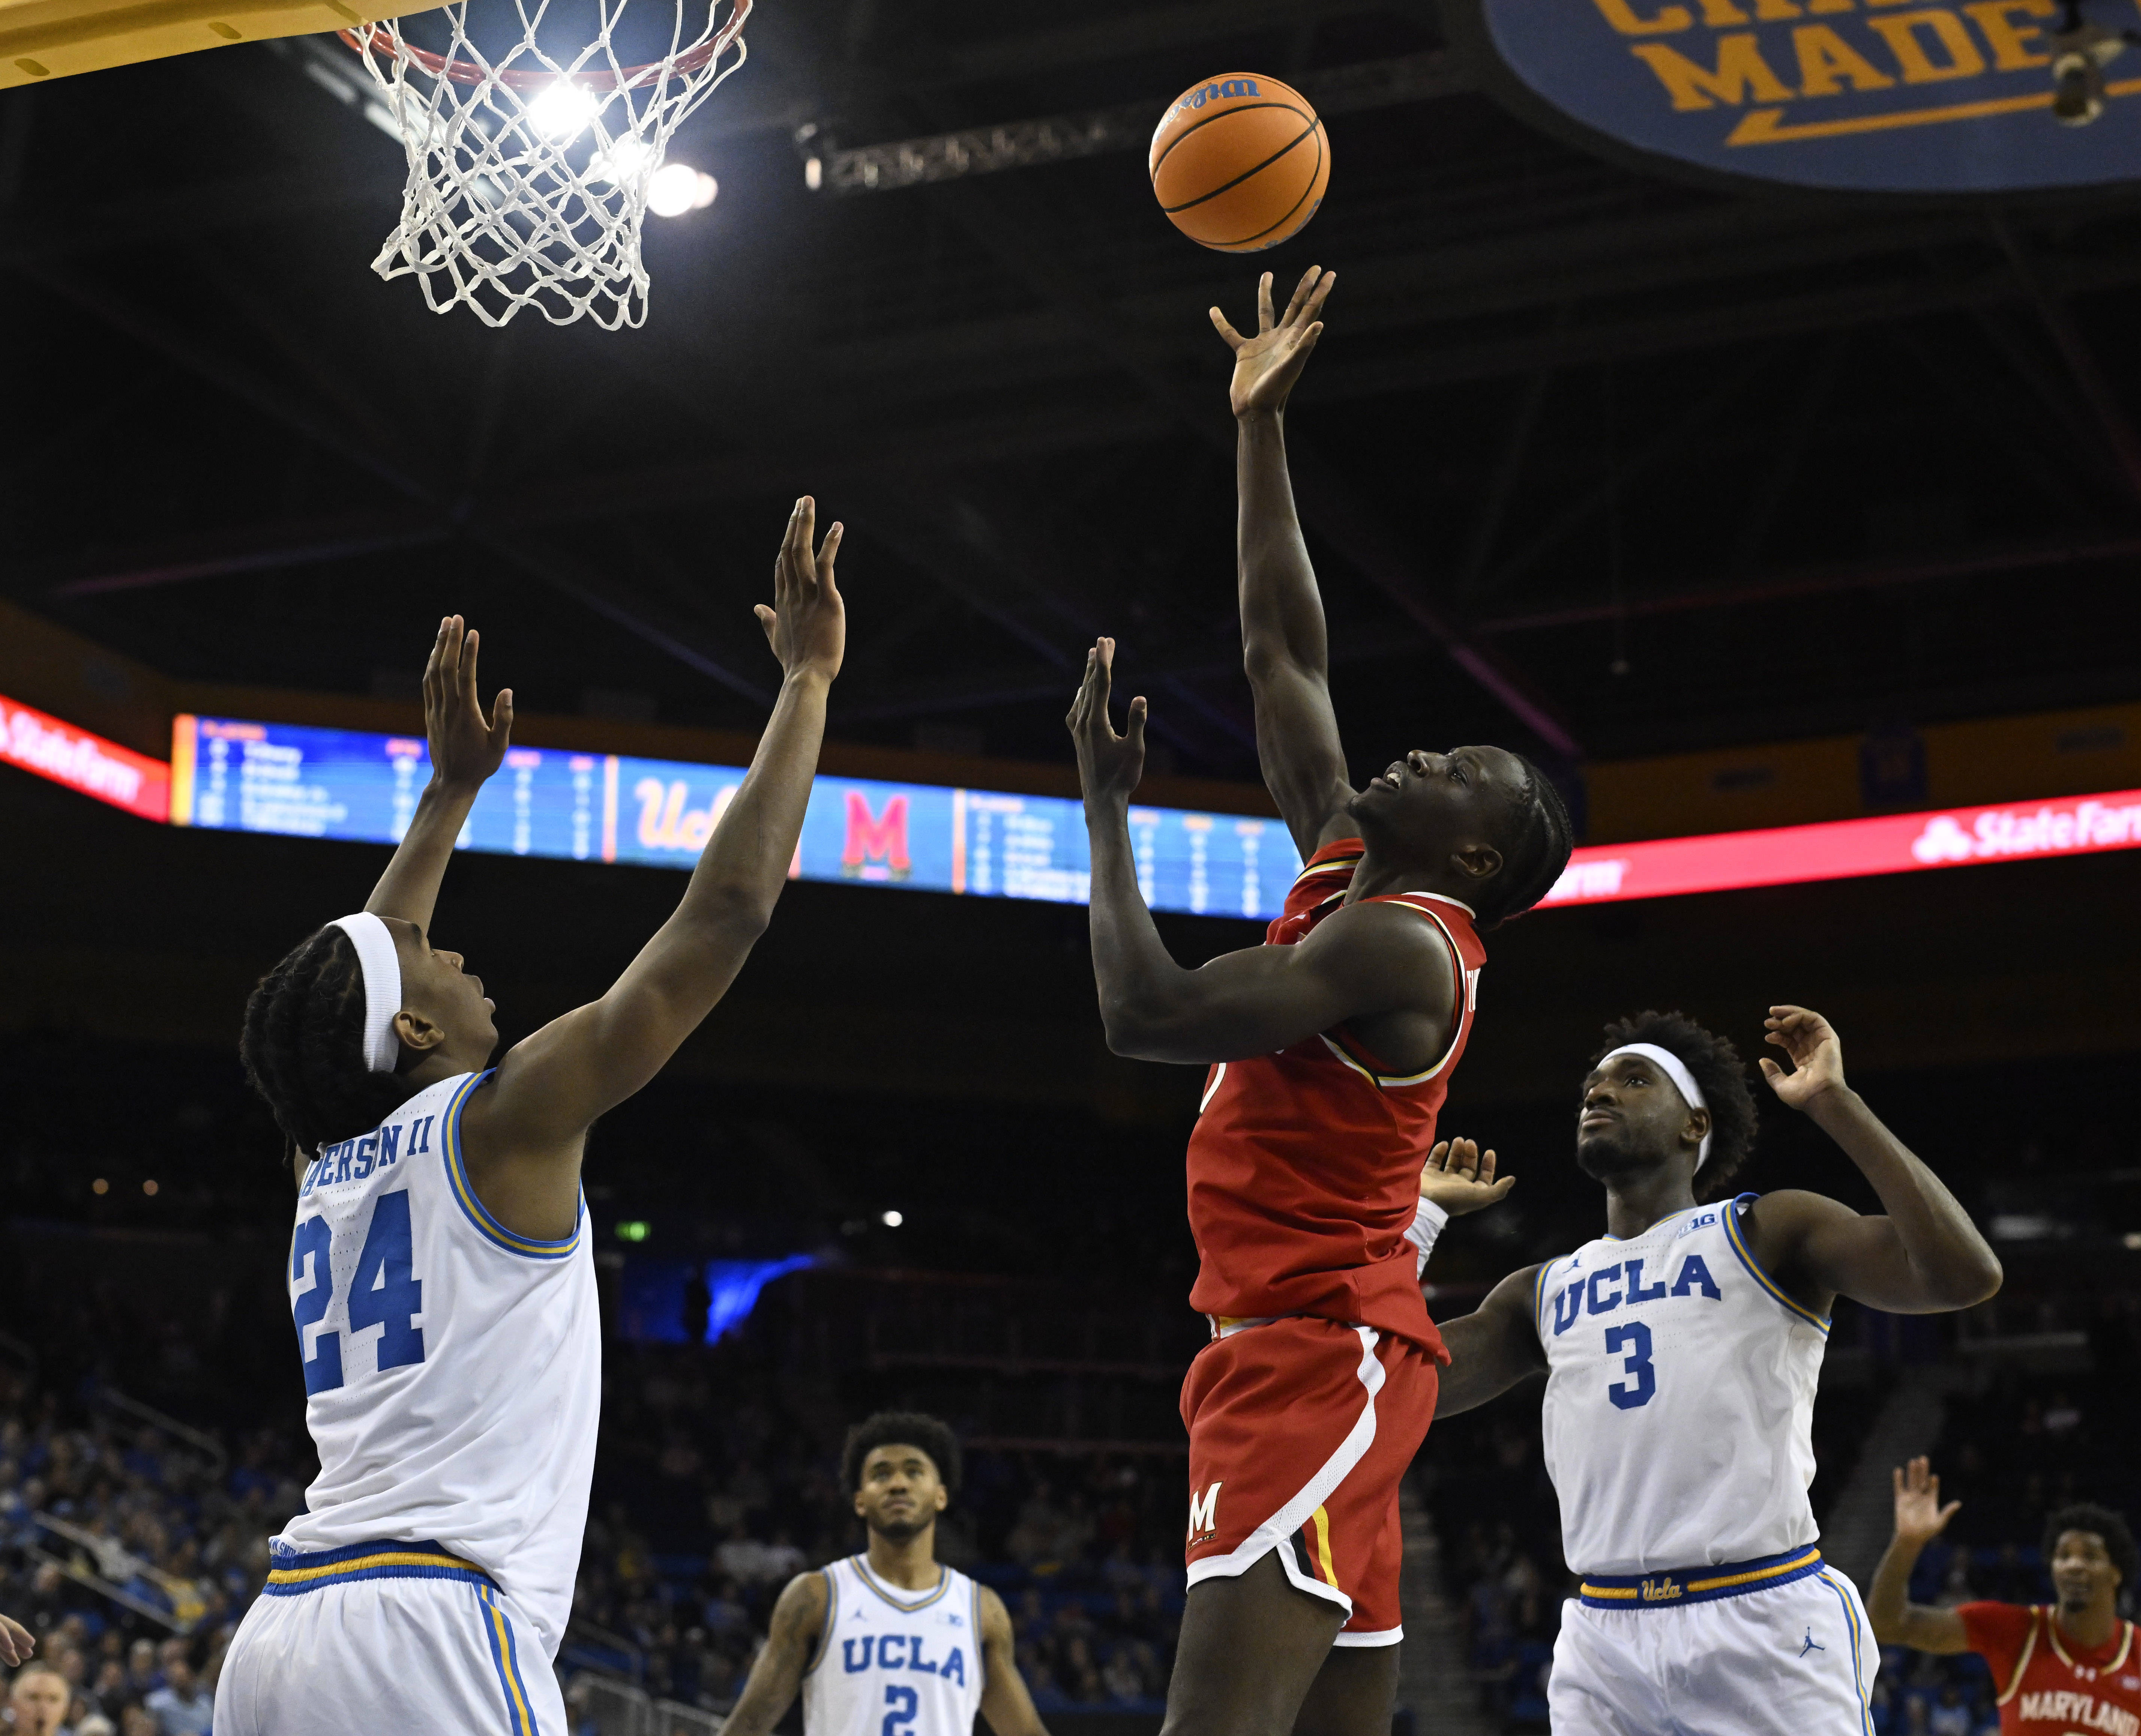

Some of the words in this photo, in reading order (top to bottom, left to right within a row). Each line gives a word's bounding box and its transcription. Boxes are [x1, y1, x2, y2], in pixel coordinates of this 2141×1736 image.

[1631, 0, 2056, 110] MADE
[843, 791, 911, 868] M
[407, 1115, 435, 1156] II
[293, 1189, 425, 1397] 24
[1554, 1255, 1721, 1336] UCLA
[1605, 1321, 1656, 1410] 3
[1188, 1481, 1223, 1543] M
[1642, 1577, 1682, 1601] Ucla
[843, 1634, 964, 1688] UCLA
[882, 1685, 918, 1736] 2
